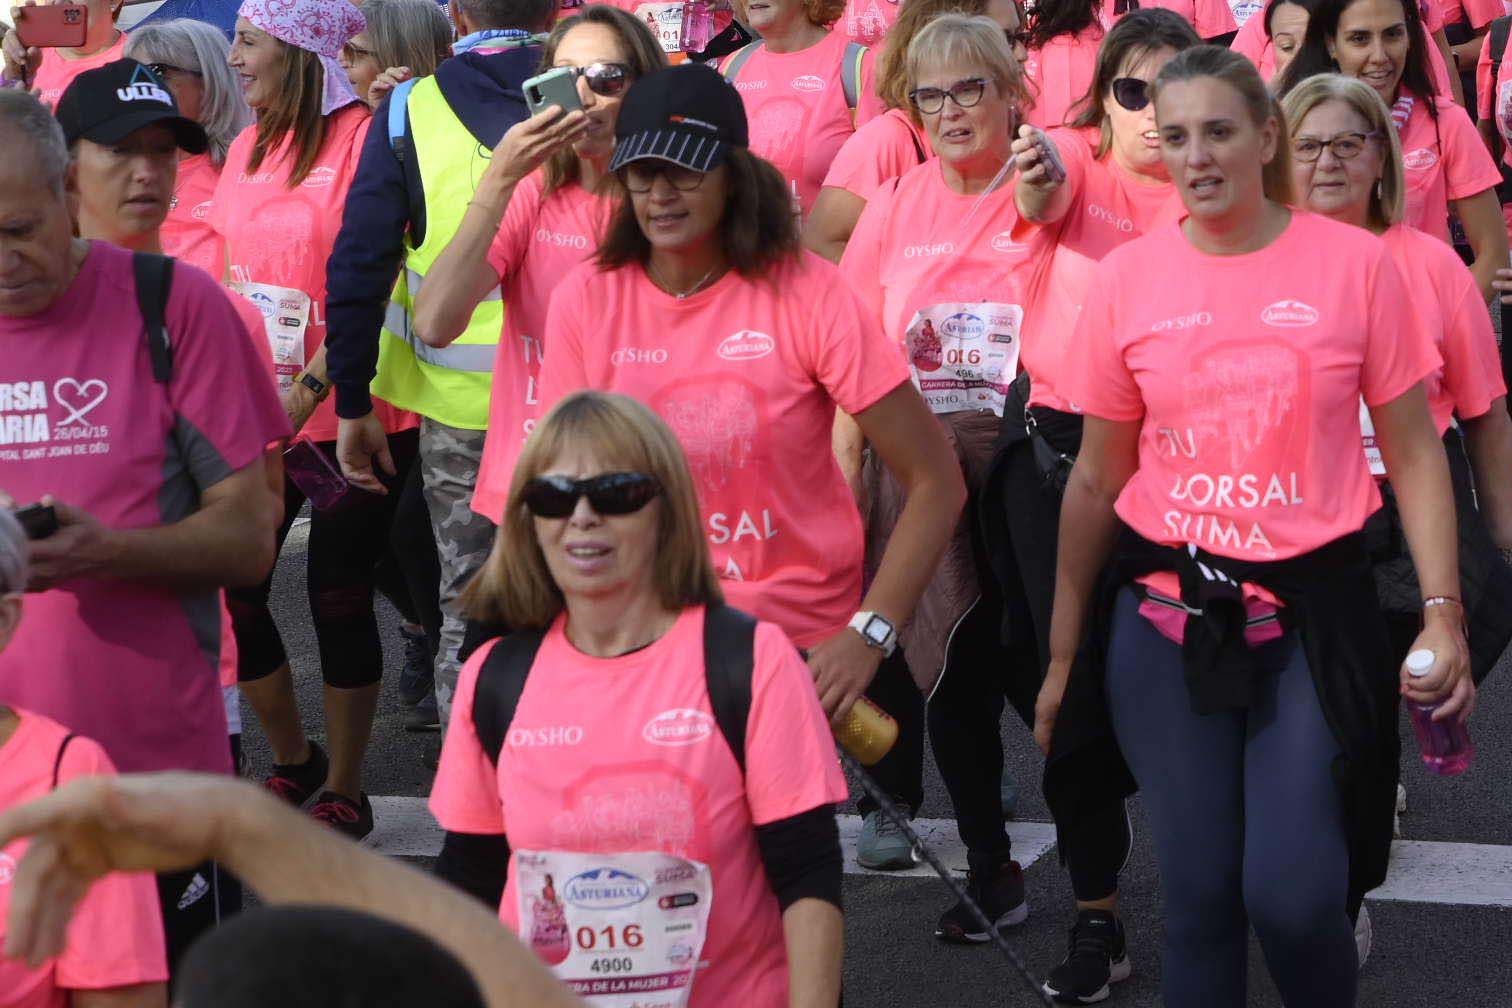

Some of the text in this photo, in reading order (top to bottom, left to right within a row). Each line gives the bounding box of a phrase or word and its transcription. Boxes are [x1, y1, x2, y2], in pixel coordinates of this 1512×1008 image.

[904, 242, 954, 258] OYSHO
[510, 726, 583, 746] OYSHO
[576, 924, 644, 950] 016
[590, 957, 633, 973] 4900
[592, 982, 609, 991] DE
[610, 980, 626, 990] LA
[628, 978, 668, 989] MUJER
